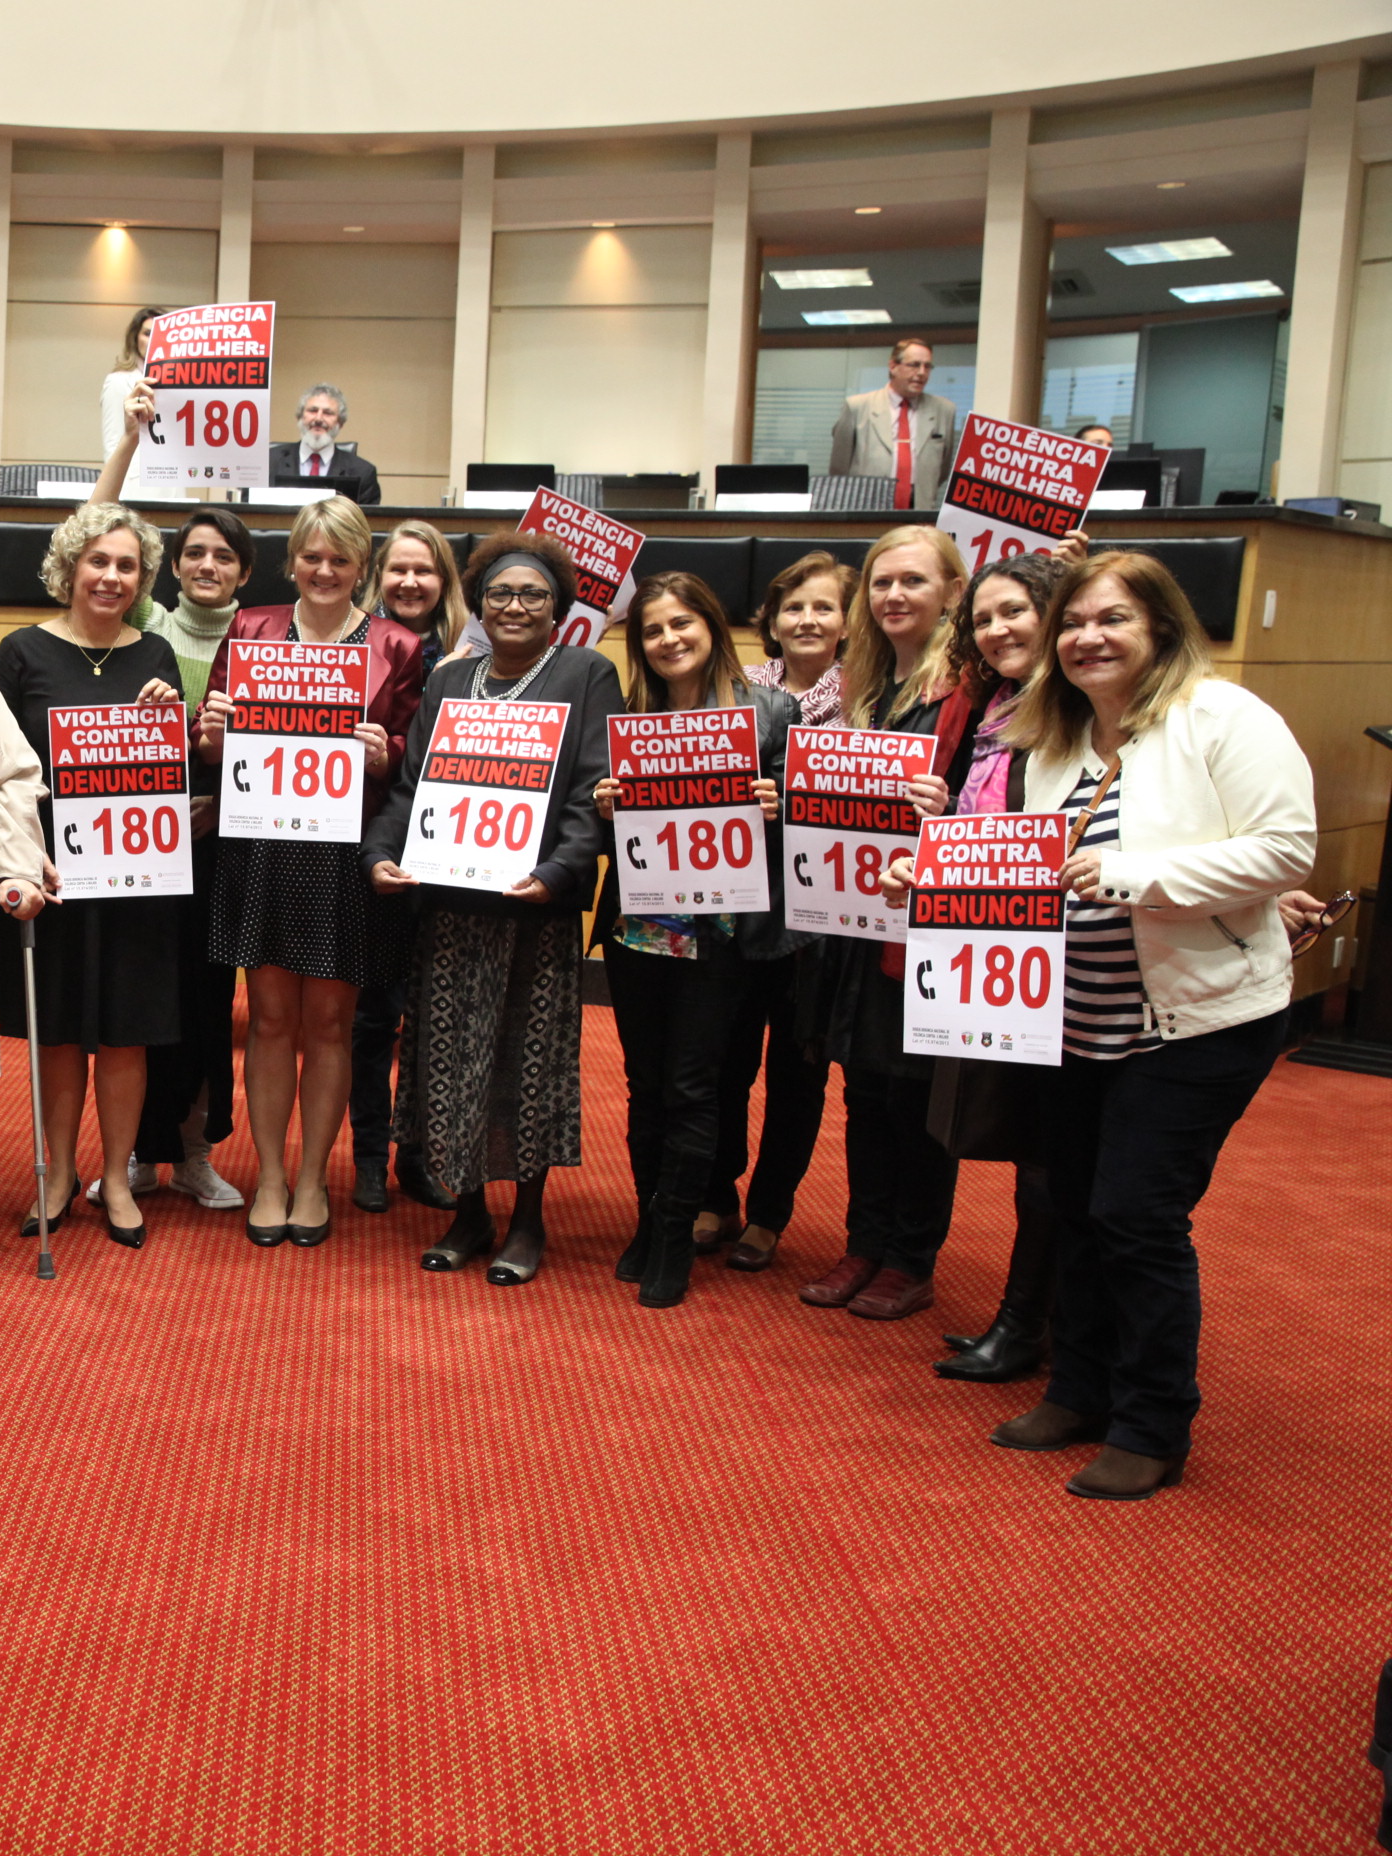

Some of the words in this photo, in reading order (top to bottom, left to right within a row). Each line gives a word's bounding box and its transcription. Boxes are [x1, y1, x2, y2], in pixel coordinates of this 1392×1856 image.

[159, 307, 266, 331] VIOLÊNCIA
[166, 324, 251, 343] CONTRA
[152, 347, 165, 361] A
[170, 342, 265, 357] MULHER:
[149, 363, 265, 385] DENUNCIE!
[177, 400, 259, 447] 180
[974, 418, 1096, 467] VIOLÊNCIA
[980, 443, 1073, 482] CONTRA
[960, 457, 975, 474] A
[981, 462, 1084, 506] MULHER:
[952, 478, 1077, 535] DENUNCIE!
[541, 493, 634, 550] VIOLÊNCIA
[543, 517, 616, 561] CONTRA
[237, 645, 361, 666] VIOLÊNCIA
[250, 666, 345, 683] CONTRA
[235, 683, 250, 698] A
[258, 684, 360, 703] MULHER:
[56, 708, 178, 727] VIOLÊNCIA
[233, 706, 360, 734] DENUNCIE!
[448, 704, 559, 723] VIOLÊNCIA
[615, 713, 748, 736] VIOLÊNCIA
[72, 727, 164, 745] CONTRA
[454, 721, 540, 740] CONTRA
[58, 749, 74, 764] A
[81, 745, 180, 763] MULHER:
[435, 737, 450, 750] A
[456, 739, 553, 758] MULHER:
[631, 734, 733, 756] CONTRA
[795, 731, 925, 758] VIOLÊNCIA
[263, 747, 352, 799] 180
[428, 757, 549, 788] DENUNCIE!
[617, 759, 634, 776] A
[641, 753, 752, 774] MULHER:
[807, 754, 904, 777] CONTRA
[60, 767, 182, 794] DENUNCIE!
[620, 776, 755, 806] DENUNCIE!
[792, 773, 808, 789] A
[814, 775, 911, 797] MULHER
[449, 797, 533, 851] 180
[792, 797, 921, 831] DENUNCIE!
[93, 806, 179, 856] 180
[928, 817, 1059, 841] VIOLÊNCIA
[657, 818, 753, 871] 180
[937, 843, 1042, 862] CONTRA
[919, 871, 935, 886] A
[942, 867, 1059, 886] MULHER:
[916, 895, 1059, 926] DENUNCIE!
[950, 944, 1051, 1009] 180
